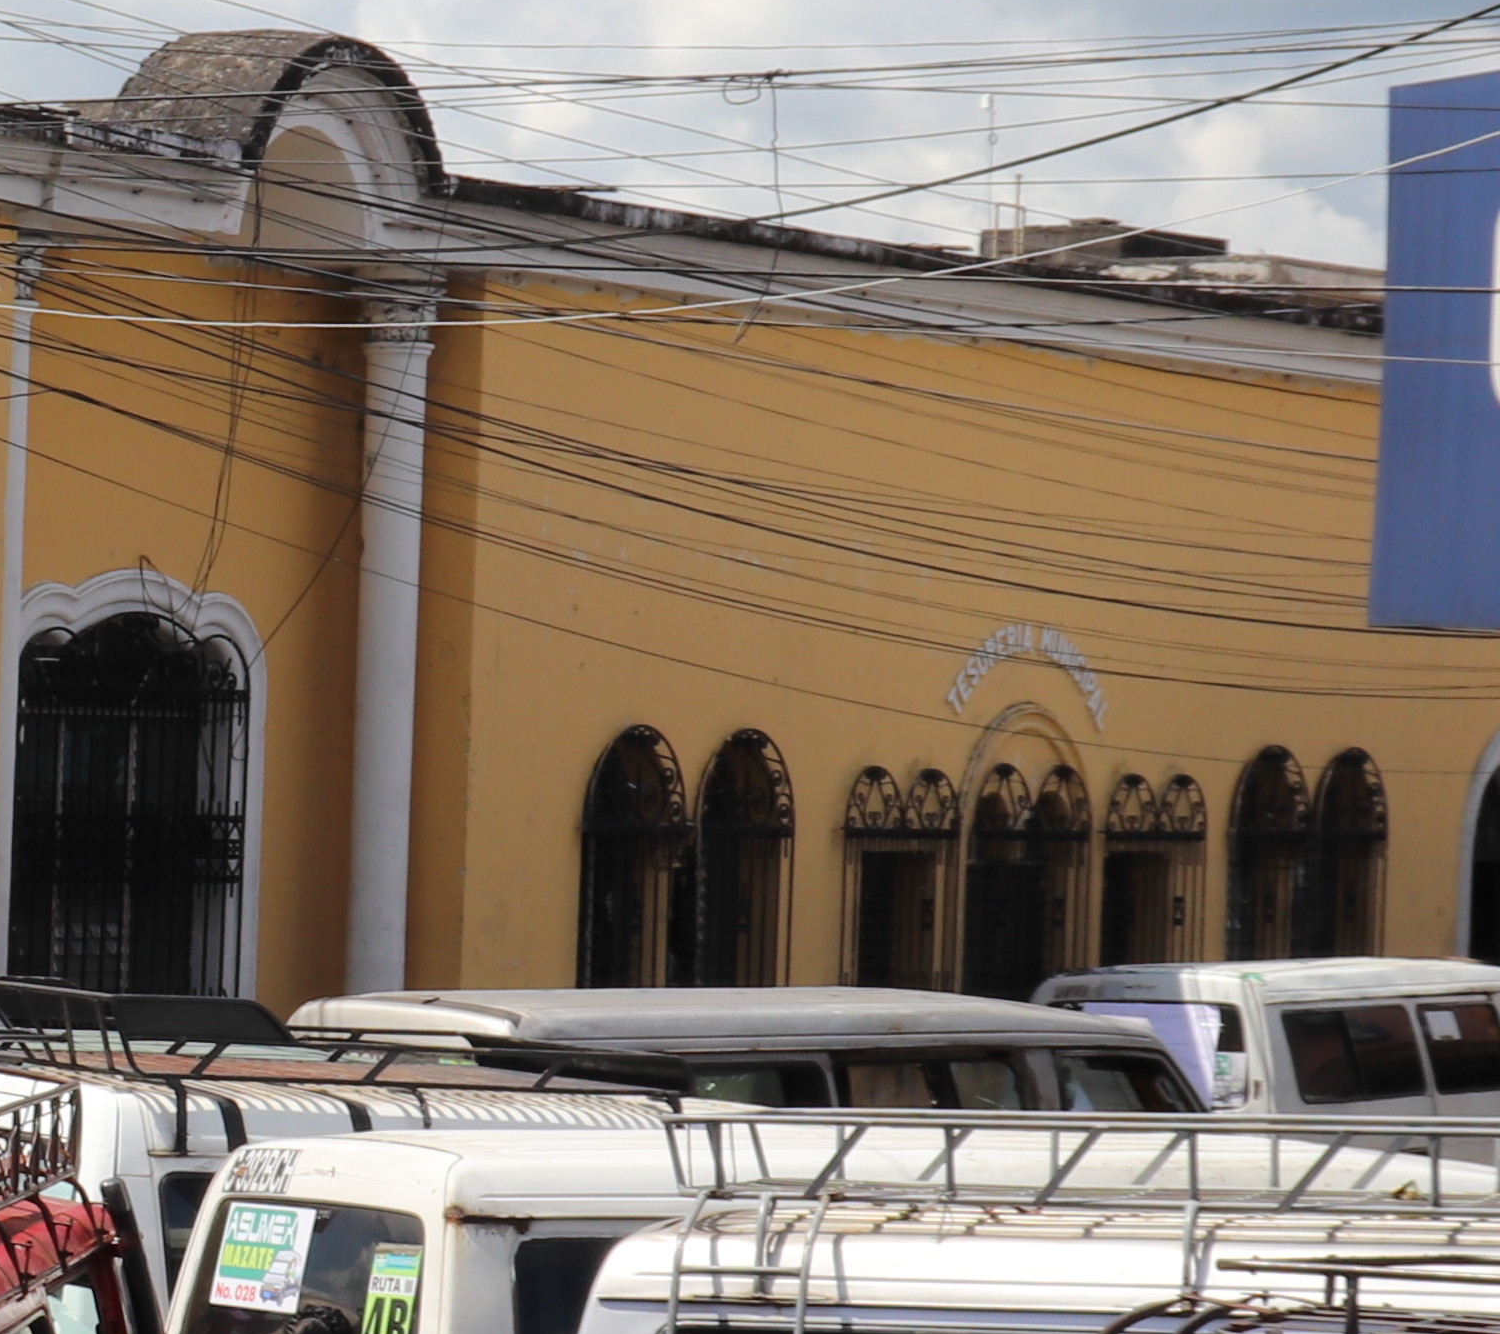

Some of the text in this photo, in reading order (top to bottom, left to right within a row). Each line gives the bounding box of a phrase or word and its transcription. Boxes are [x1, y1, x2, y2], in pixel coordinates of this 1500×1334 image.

[225, 1210, 299, 1245] ASUMEX
[220, 1244, 275, 1268] MAZATE
[215, 1284, 257, 1301] No. 028
[371, 1277, 401, 1292] RUTA
